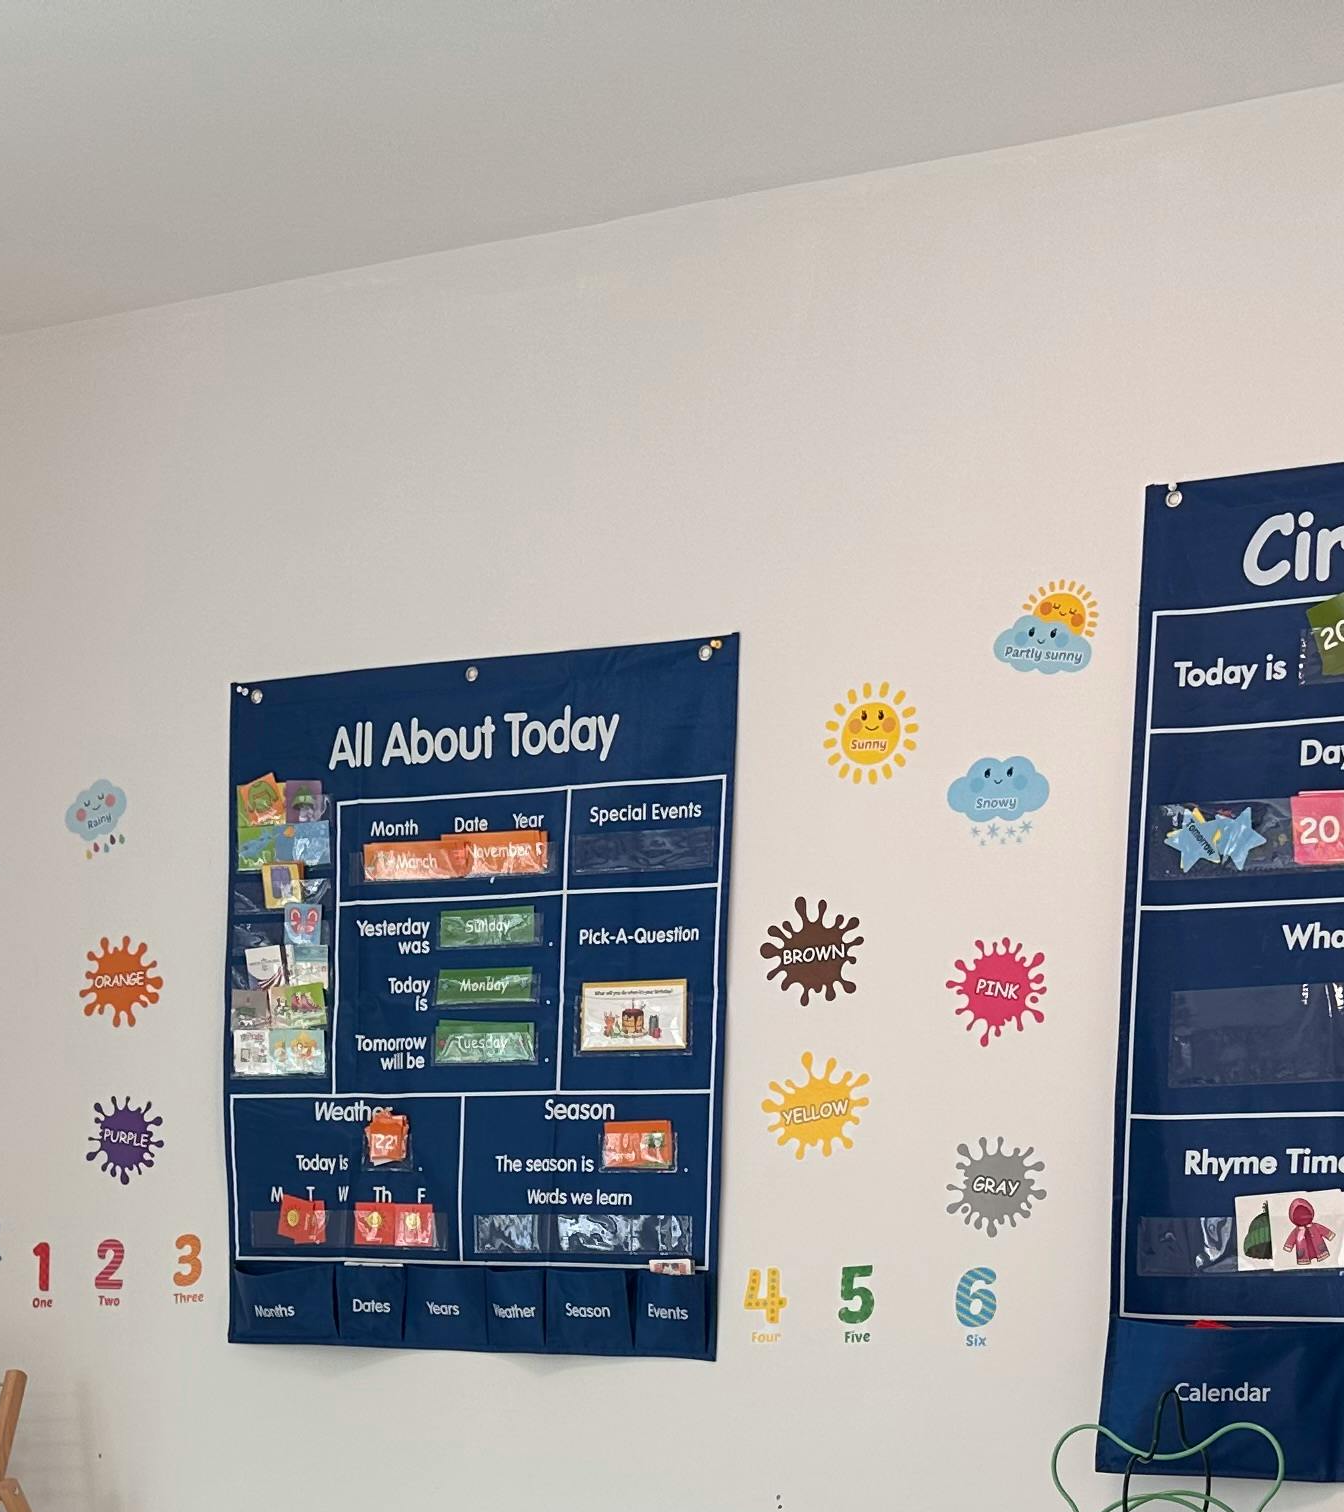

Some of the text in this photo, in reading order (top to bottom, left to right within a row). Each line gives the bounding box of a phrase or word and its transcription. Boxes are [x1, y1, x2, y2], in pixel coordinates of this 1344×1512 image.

[1005, 645, 1083, 665] Partly sunny
[1173, 653, 1287, 690] Today is
[329, 704, 621, 771] All About Today
[850, 738, 888, 752] Sunny
[590, 801, 702, 826] Special Events
[975, 796, 1017, 811] Snowy
[86, 812, 113, 831] Rainy
[370, 812, 545, 838] Month Date Year
[1299, 814, 1340, 845] 20
[465, 841, 531, 859] November
[356, 917, 430, 939] Yesterday
[579, 926, 700, 946] Pick-A-Question
[398, 940, 430, 955] was
[782, 943, 846, 966] BROWN
[94, 970, 145, 988] ORANGE
[388, 975, 509, 997] Today Monday
[975, 977, 1020, 1001] PINK
[415, 996, 428, 1012] is
[355, 1034, 427, 1052] Tomorrow
[381, 1051, 425, 1070] will be
[544, 1099, 615, 1121] Season
[782, 1099, 850, 1126] YELLOW
[103, 1127, 149, 1148] PURPLE
[296, 1154, 349, 1175] Today is
[495, 1155, 523, 1173] The
[525, 1157, 577, 1173] season
[581, 1155, 594, 1173] is
[1184, 1149, 1278, 1182] Rhyme
[270, 1186, 427, 1204] M T W Th F
[971, 1175, 1021, 1198] GRAY
[527, 1188, 633, 1206] Words we learn
[32, 1242, 51, 1292] 1
[94, 1238, 126, 1290] 2
[172, 1234, 203, 1287] 3
[32, 1297, 53, 1309] One
[98, 1295, 121, 1308] Two
[173, 1292, 205, 1305] Three
[744, 1267, 788, 1325] 4
[838, 1265, 876, 1325] 5
[955, 1266, 998, 1328] 6
[255, 1303, 296, 1319] Months
[352, 1298, 391, 1314] Dates
[425, 1301, 460, 1316] Years
[565, 1303, 611, 1319] Season
[647, 1303, 689, 1320] Events
[751, 1331, 782, 1344] Four
[844, 1330, 872, 1344] Five
[965, 1334, 988, 1348] Six
[1174, 1381, 1272, 1405] Calendar
